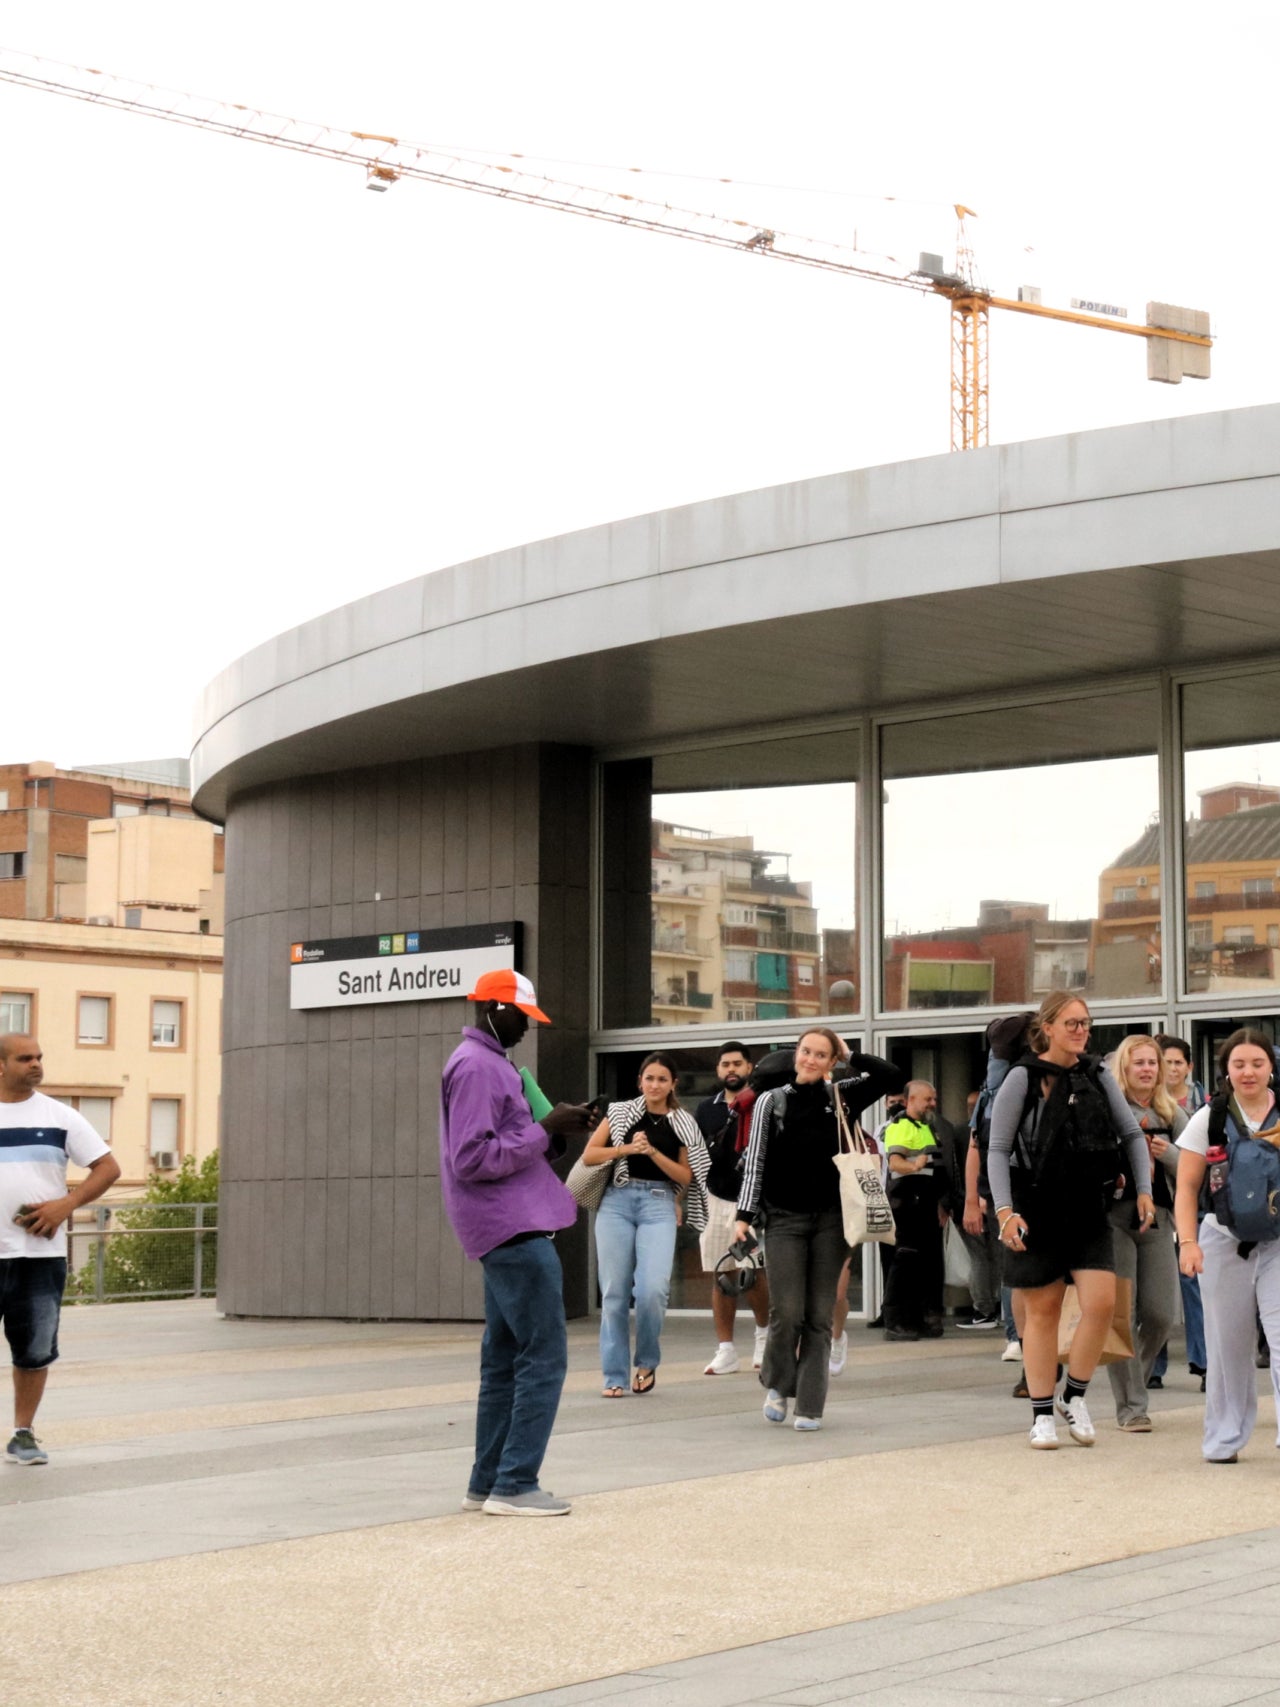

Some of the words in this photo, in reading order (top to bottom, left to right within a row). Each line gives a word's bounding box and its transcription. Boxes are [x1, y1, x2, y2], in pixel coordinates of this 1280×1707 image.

[379, 940, 391, 951] R2
[407, 938, 419, 948] R11
[338, 970, 382, 996] Sant
[387, 964, 461, 992] Andreu
